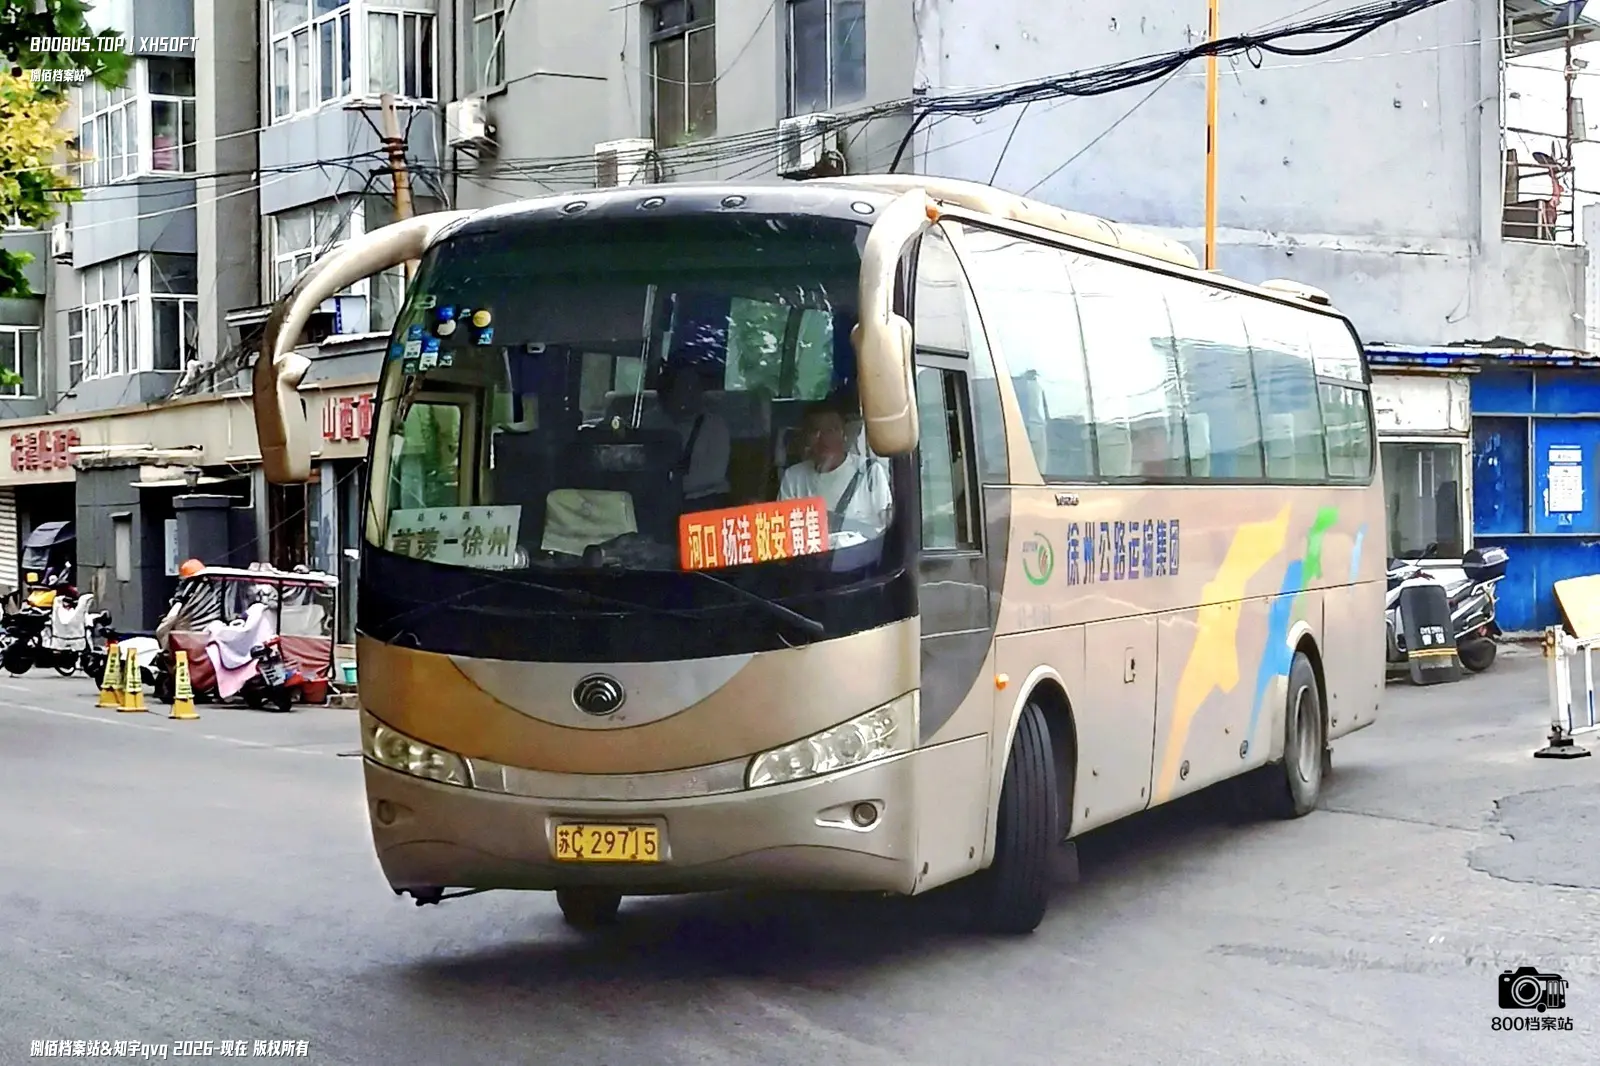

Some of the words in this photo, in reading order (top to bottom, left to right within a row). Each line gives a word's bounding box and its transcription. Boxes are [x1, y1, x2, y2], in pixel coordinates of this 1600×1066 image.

[687, 523, 718, 569] 河口
[721, 514, 754, 566] 杨洼
[755, 509, 787, 561] 敬安
[789, 503, 822, 556] 黄集
[1067, 518, 1180, 586] 徐州公路运输集团
